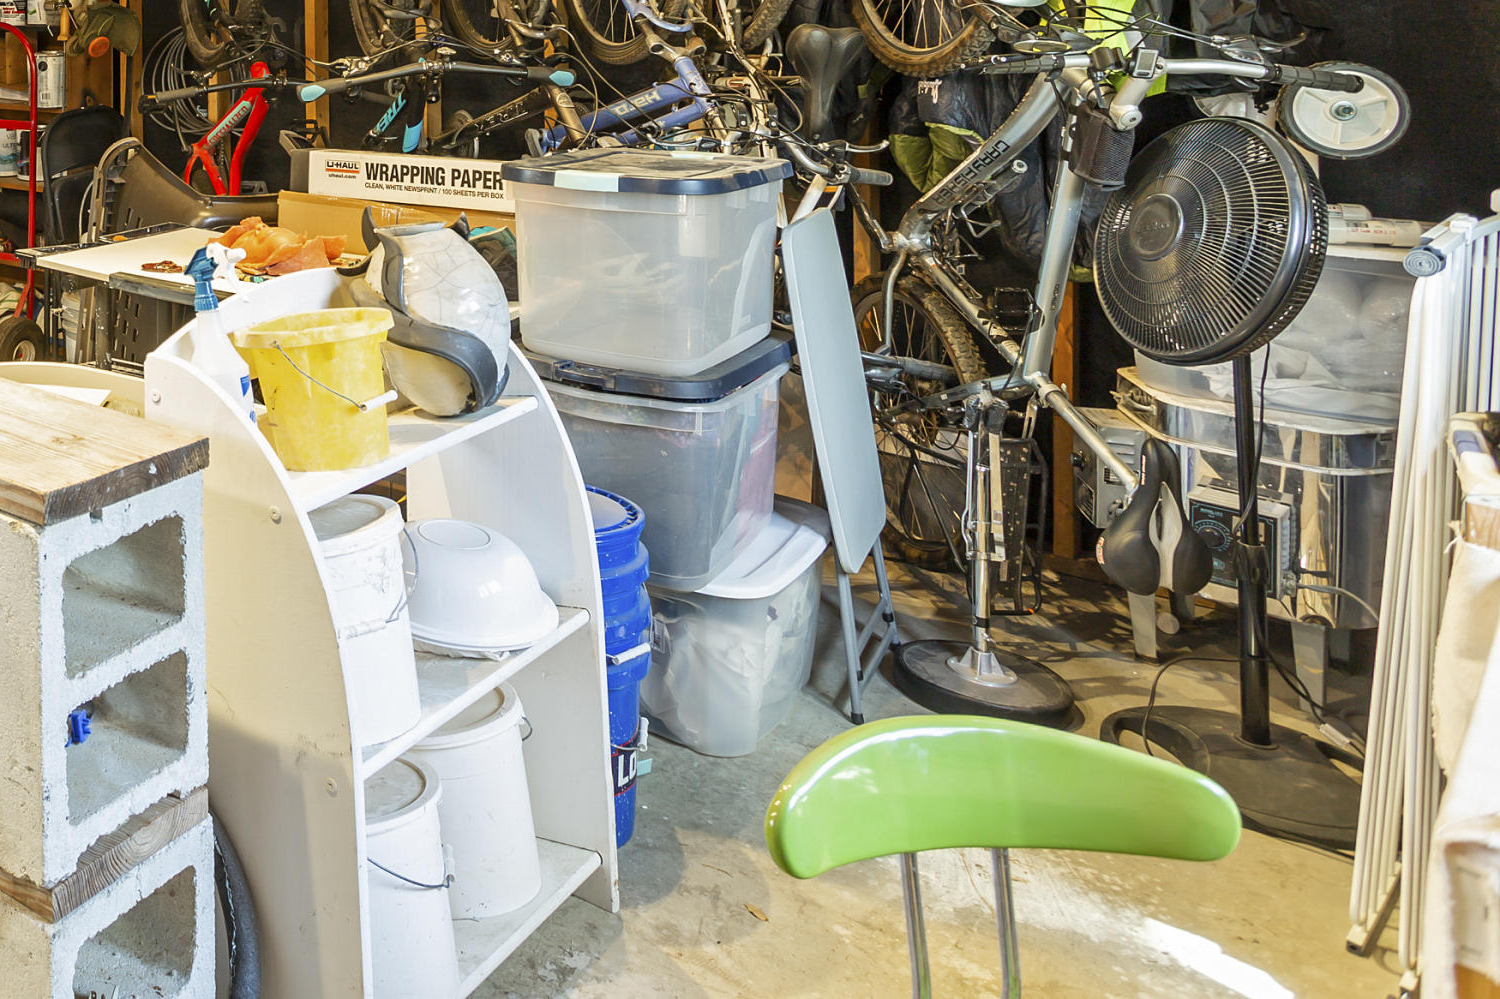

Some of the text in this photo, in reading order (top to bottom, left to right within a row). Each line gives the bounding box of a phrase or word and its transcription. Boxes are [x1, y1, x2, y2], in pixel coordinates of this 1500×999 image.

[365, 162, 504, 190] WRAPPING PAPER
[364, 182, 385, 190] CLEAN,
[385, 183, 403, 191] WHITE
[404, 184, 437, 194] NEWSPRINT
[453, 189, 476, 197] SHEETS
